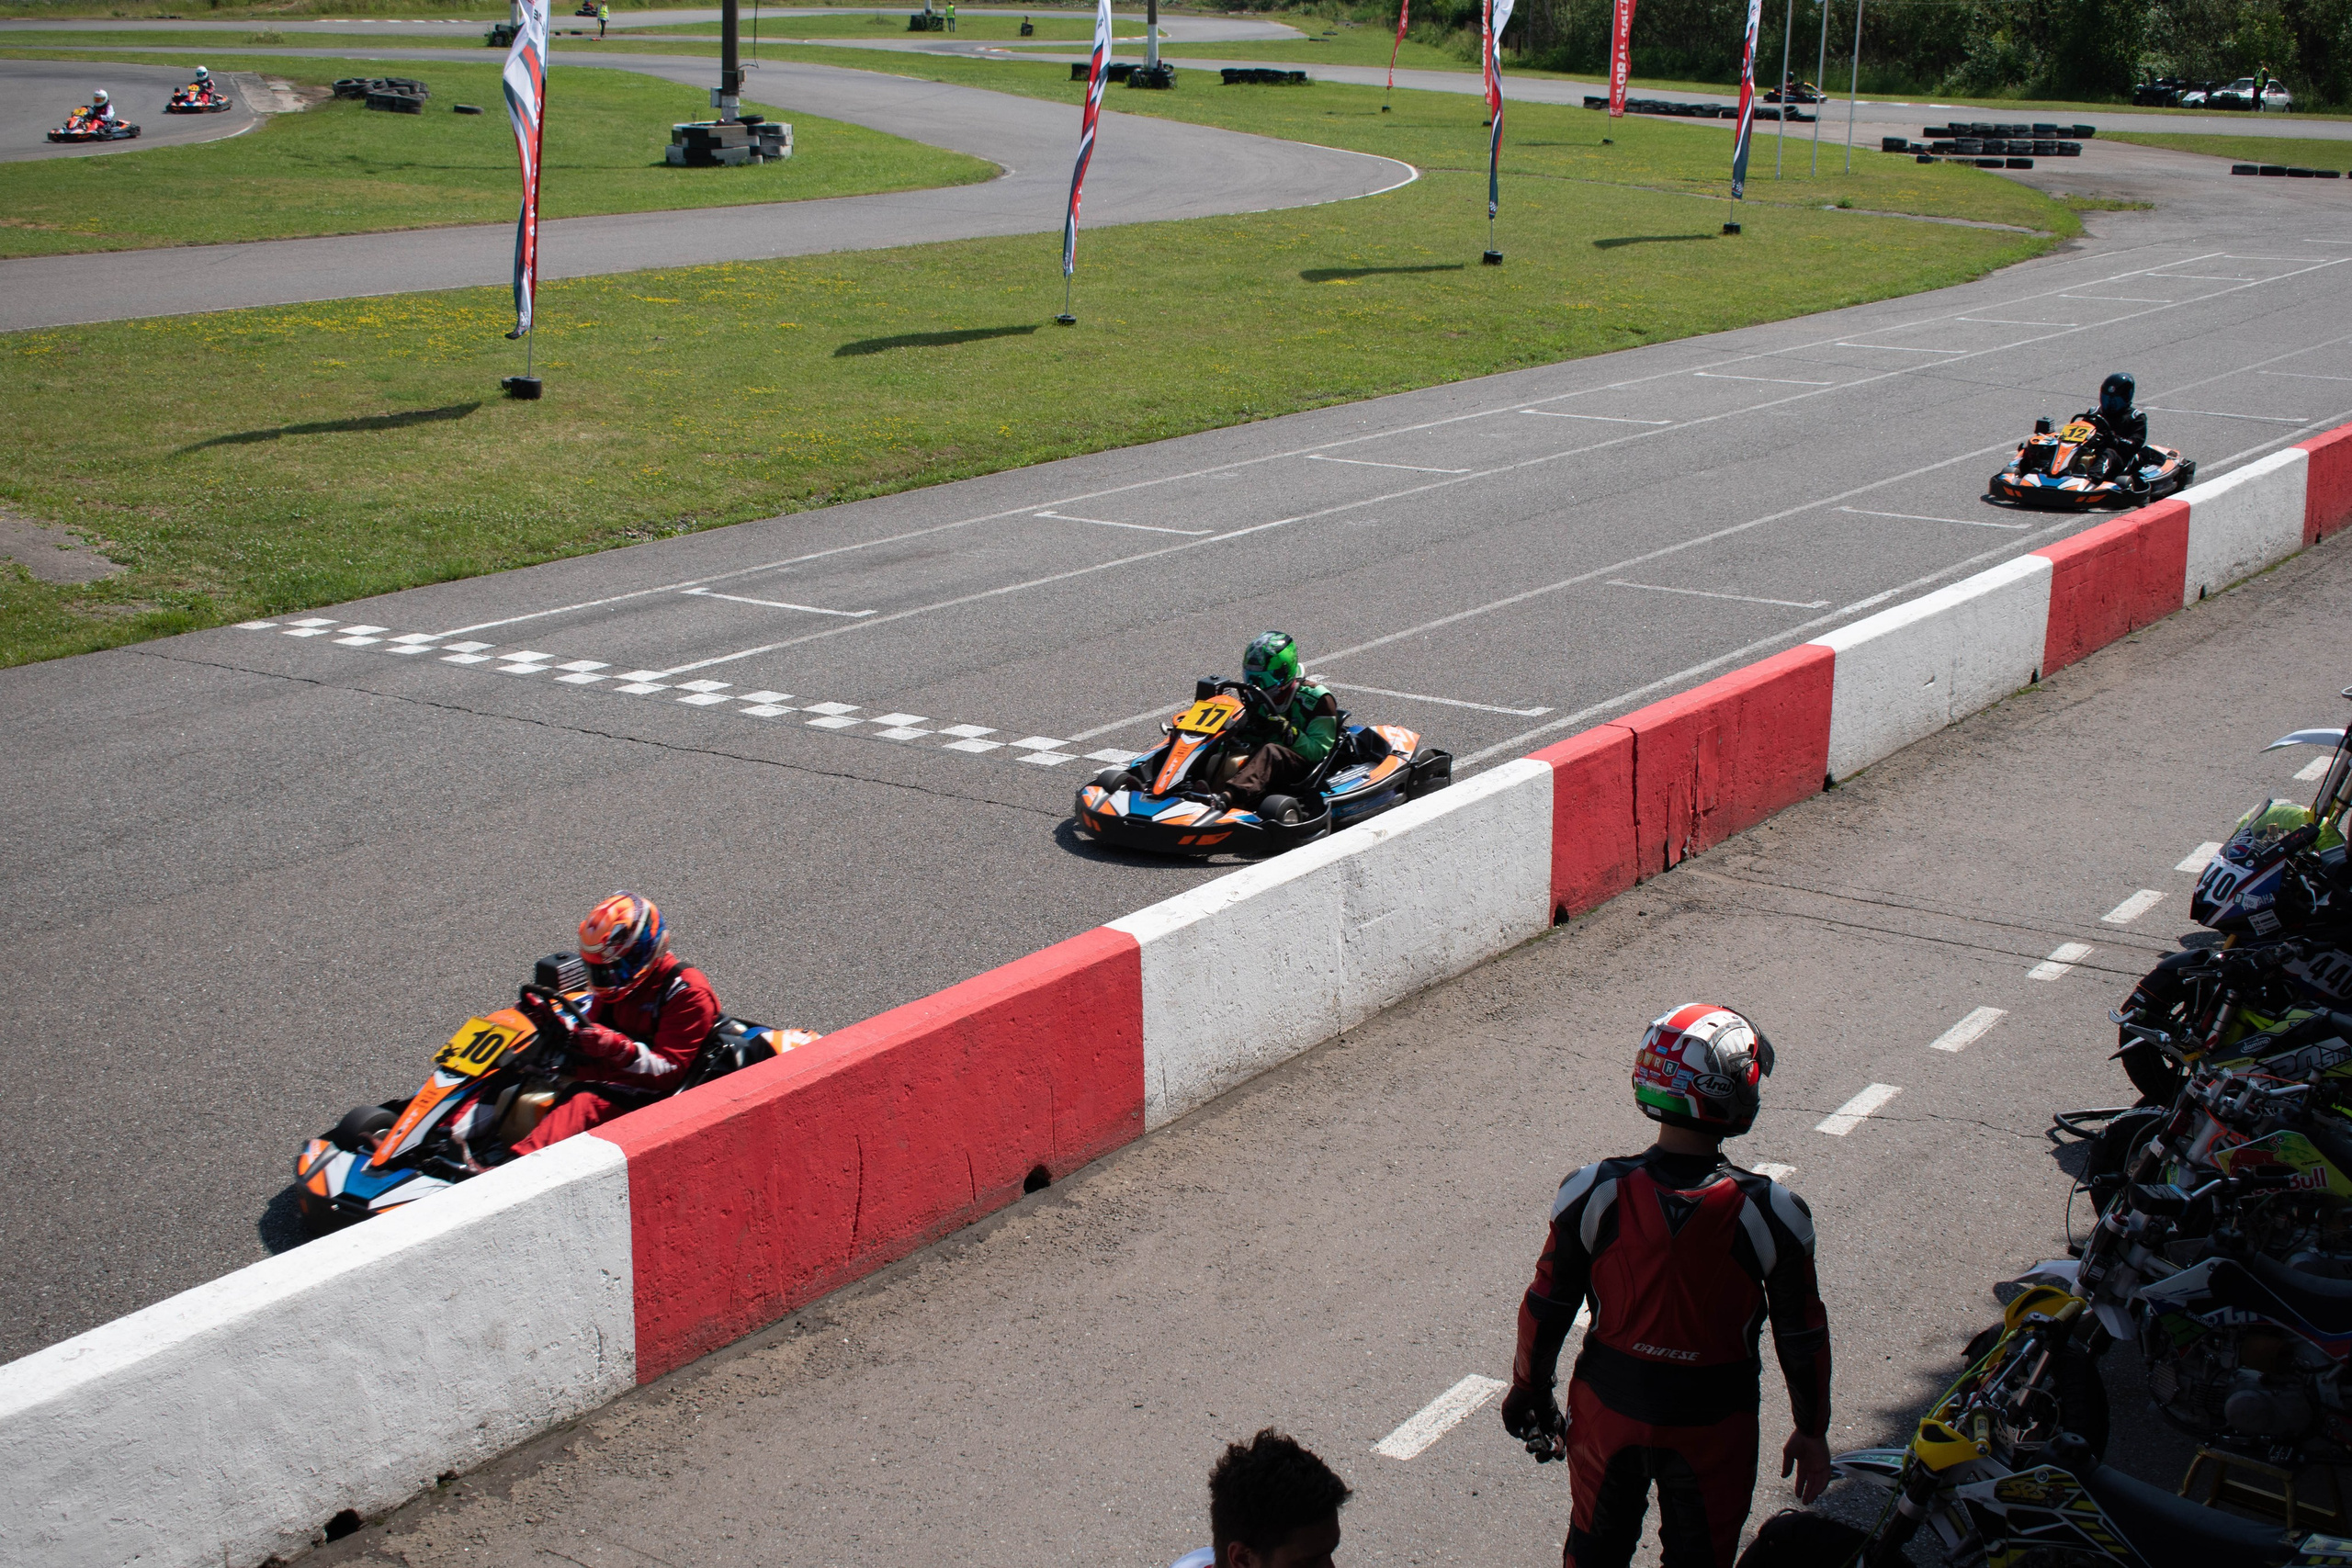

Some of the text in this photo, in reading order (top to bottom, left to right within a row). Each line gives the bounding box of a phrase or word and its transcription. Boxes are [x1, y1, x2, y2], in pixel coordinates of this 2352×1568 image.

[2067, 426, 2087, 439] 12
[1194, 707, 1228, 727] 17
[459, 1030, 504, 1065] 10
[1698, 1076, 1731, 1092] Arai
[1632, 1342, 1702, 1361] DAINESE
